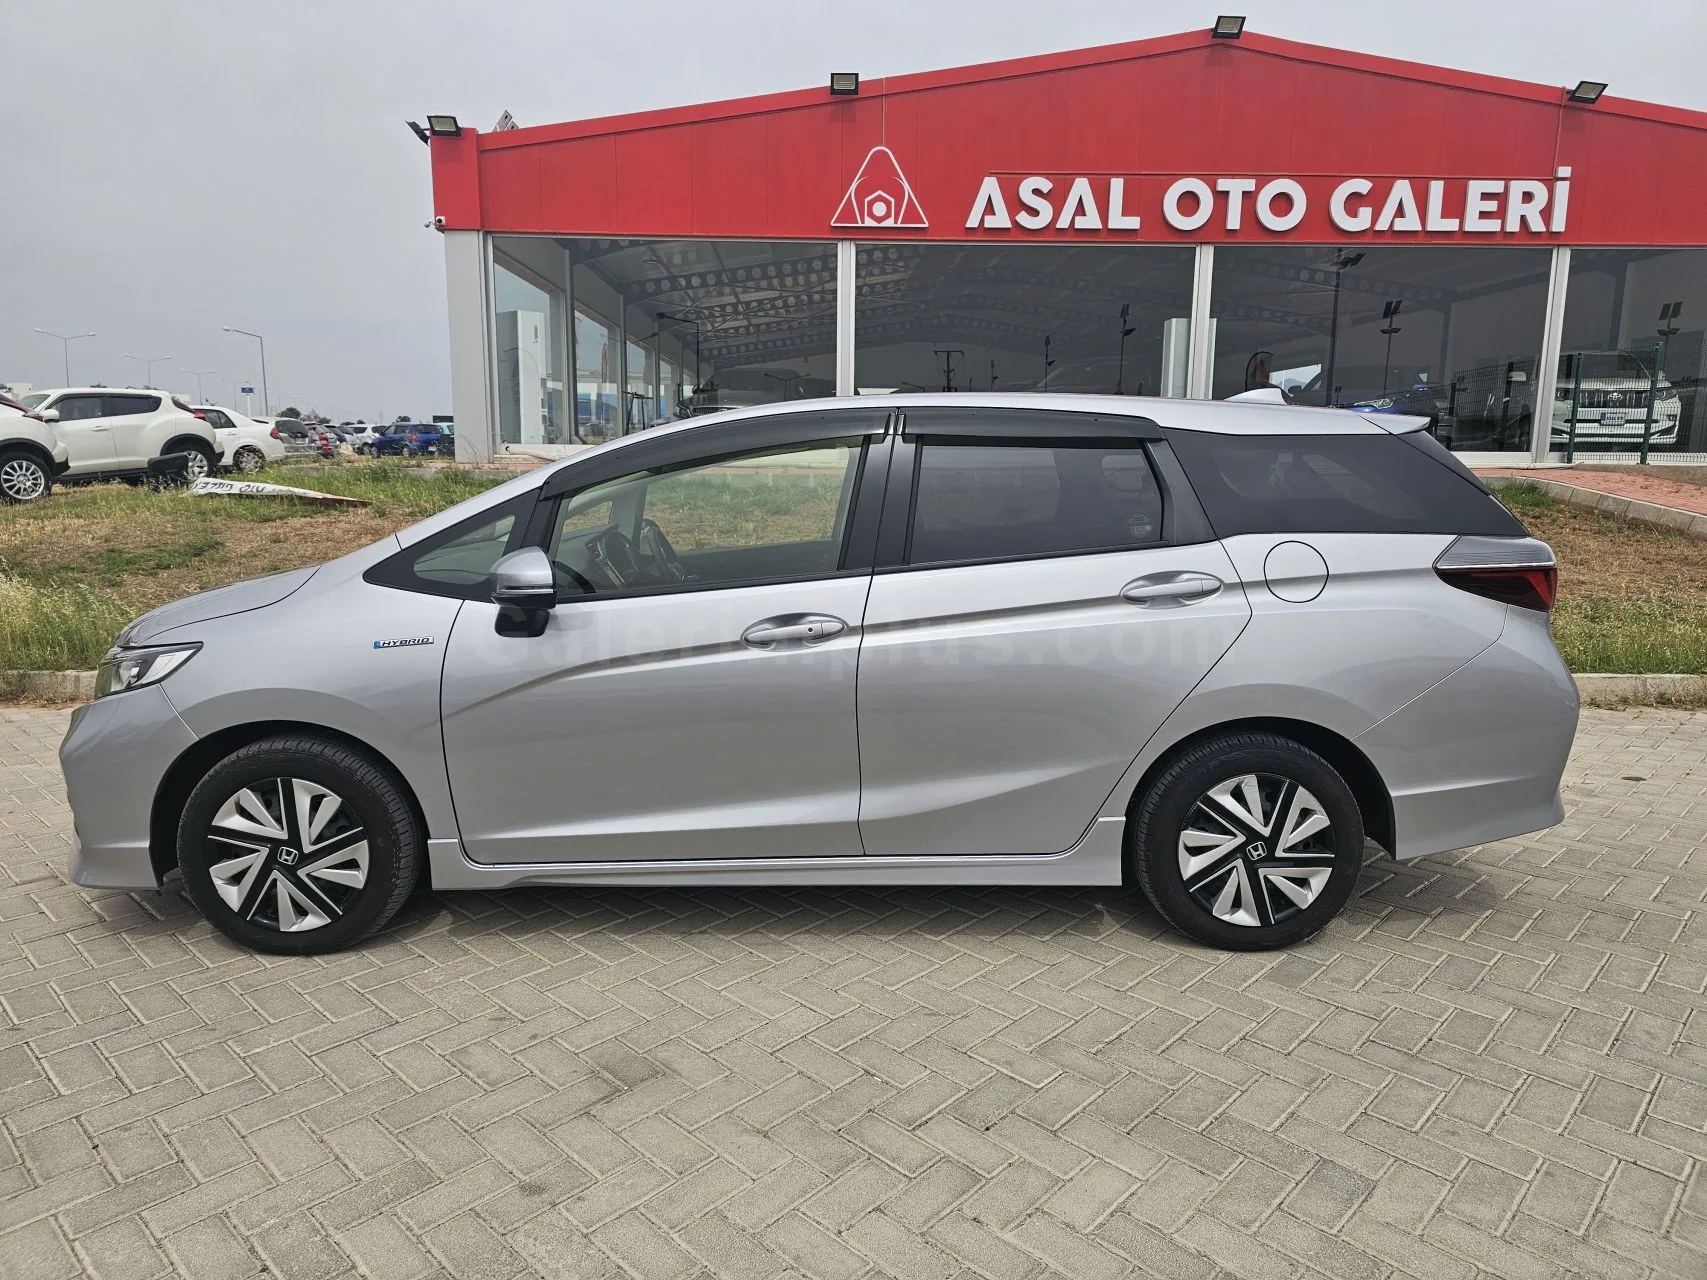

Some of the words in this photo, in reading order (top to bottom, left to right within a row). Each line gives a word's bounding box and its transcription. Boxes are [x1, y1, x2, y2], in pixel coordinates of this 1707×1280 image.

[965, 176, 1141, 231] ASAL
[1162, 177, 1308, 233] OTO
[1329, 166, 1572, 234] GALERİ
[381, 637, 430, 648] HYBRID
